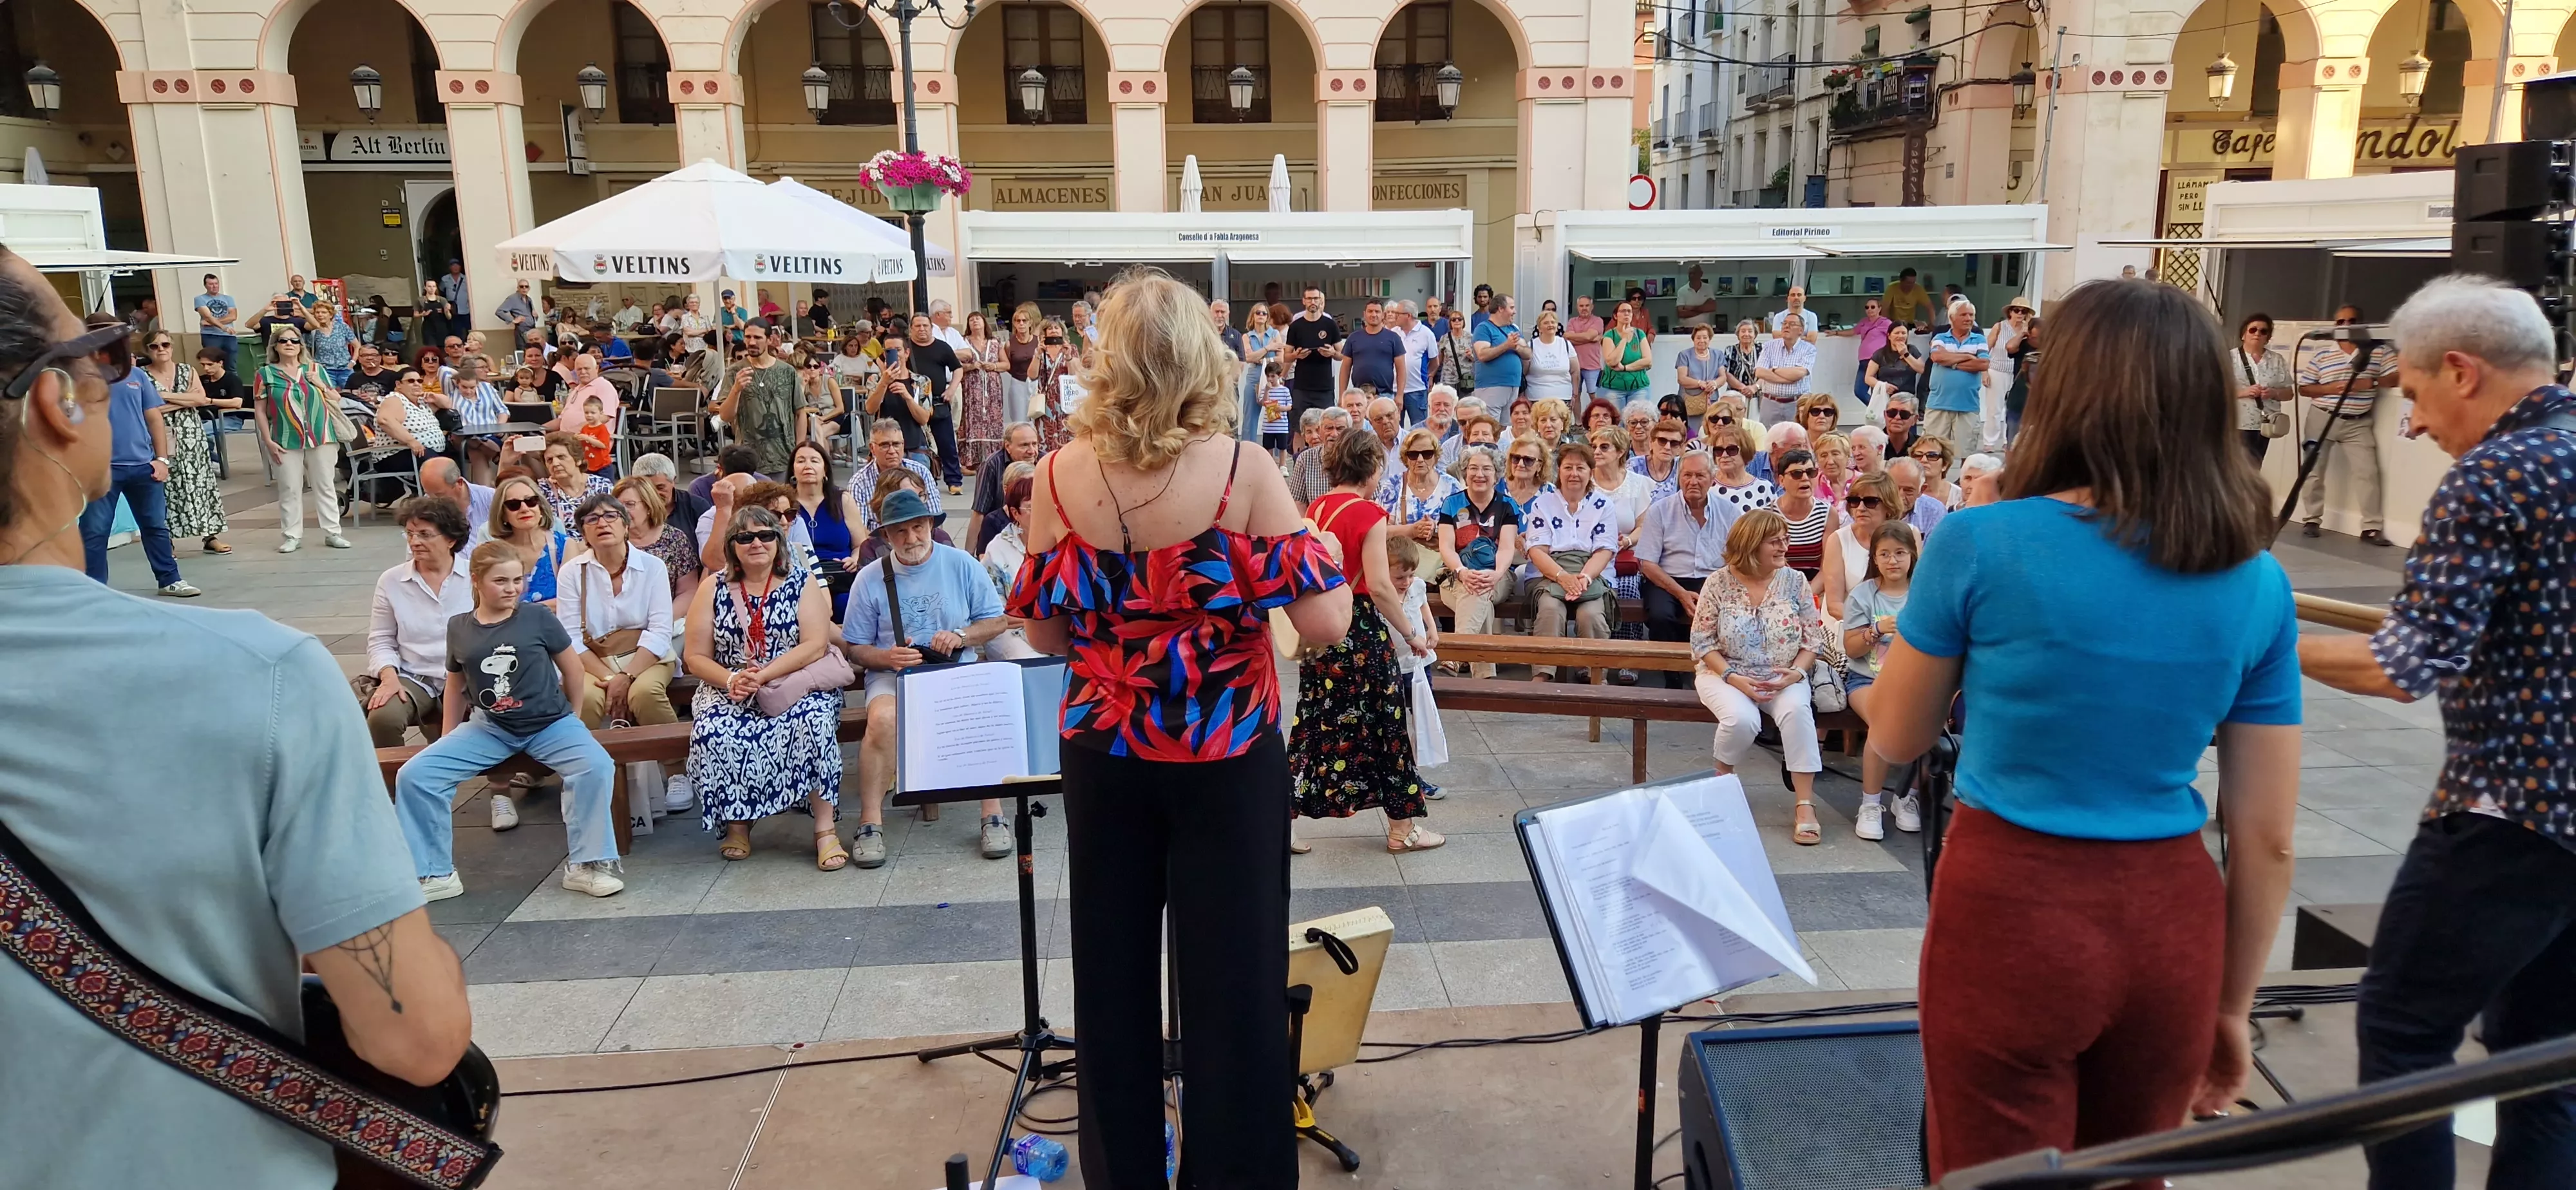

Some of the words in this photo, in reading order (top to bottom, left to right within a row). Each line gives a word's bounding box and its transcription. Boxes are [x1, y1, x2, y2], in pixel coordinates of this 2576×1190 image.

[351, 135, 382, 155] Alt
[387, 135, 446, 155] Berlin
[2356, 115, 2459, 158] ndol
[995, 187, 1106, 204] ALMACENES
[1200, 186, 1222, 202] AN
[1231, 185, 1268, 202] JUA
[1372, 183, 1461, 201] ONFECCIONES
[1179, 232, 1203, 241] Consello
[1214, 232, 1229, 241] Fabla
[1229, 232, 1259, 242] Aragonesa
[1772, 227, 1803, 236] Editorial
[1804, 227, 1830, 236] Pirineo
[518, 253, 549, 272] VELTINS
[611, 255, 690, 275] VELTINS
[769, 255, 843, 275] VELTINS
[880, 258, 903, 276] VELTINS
